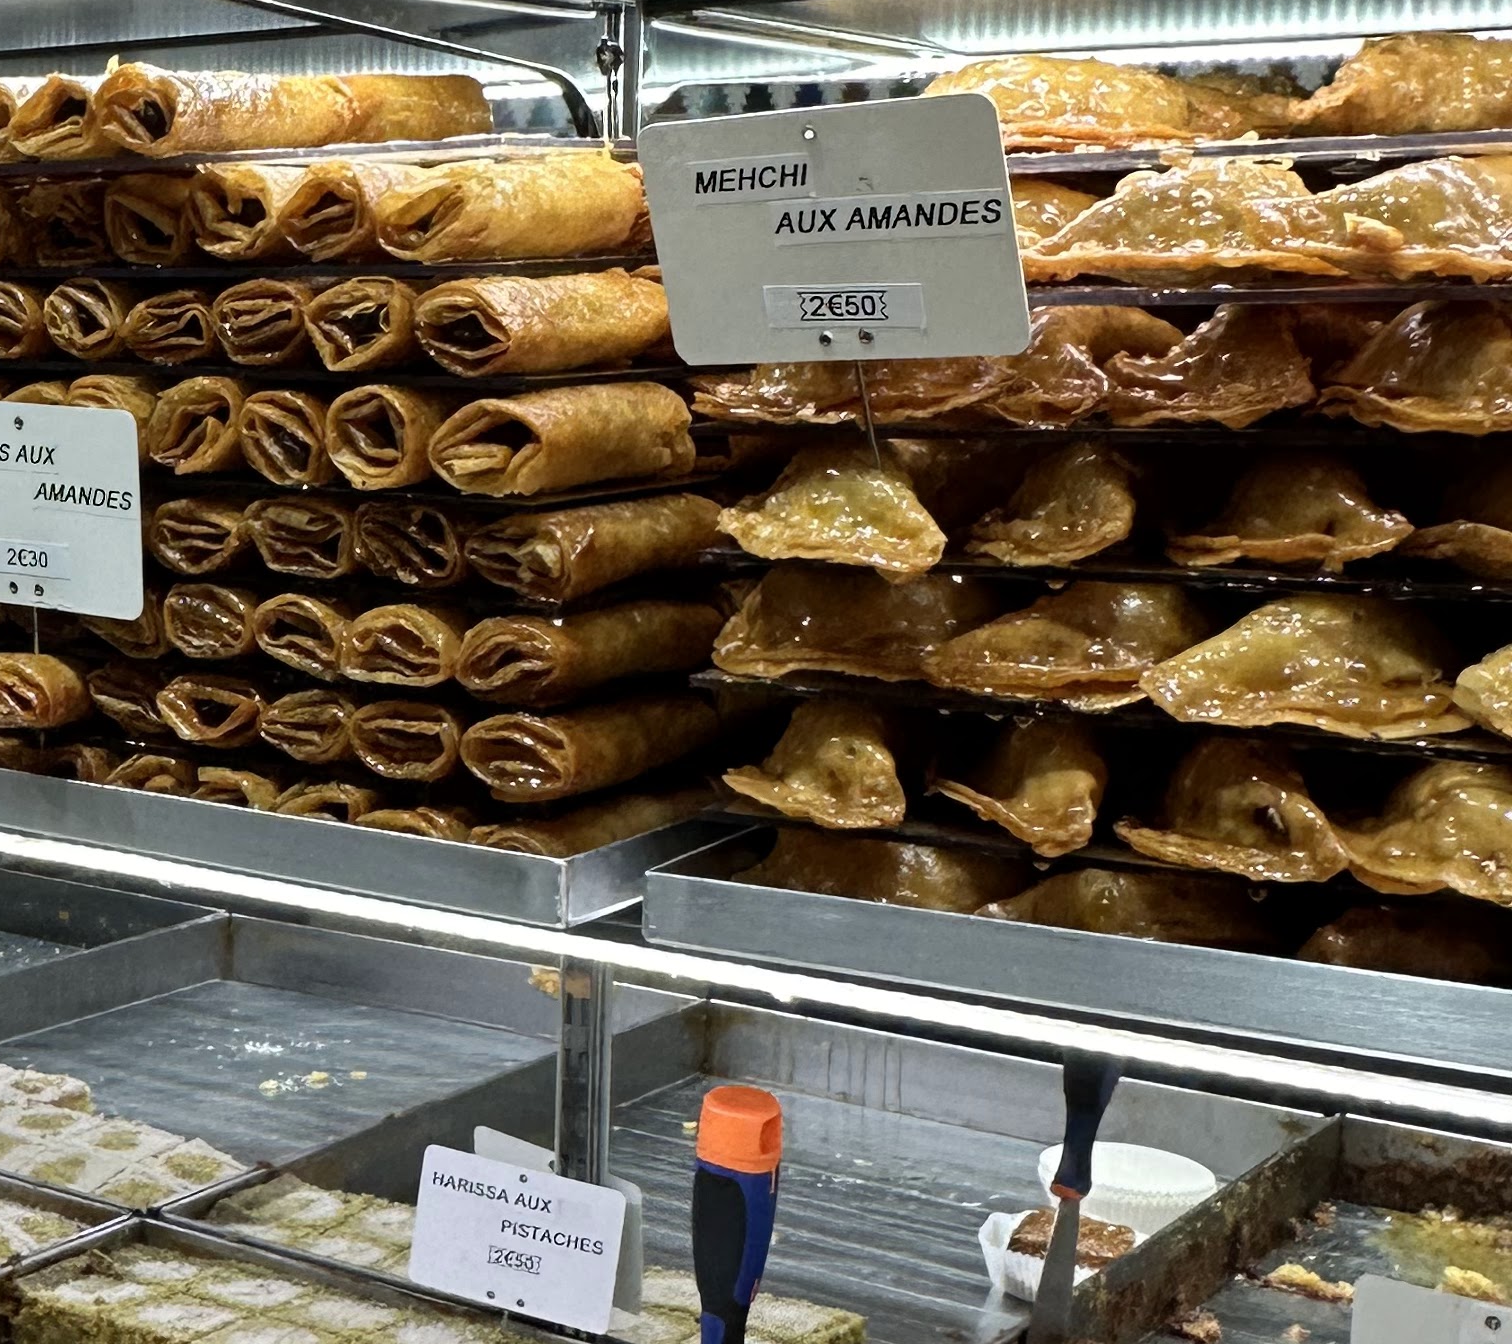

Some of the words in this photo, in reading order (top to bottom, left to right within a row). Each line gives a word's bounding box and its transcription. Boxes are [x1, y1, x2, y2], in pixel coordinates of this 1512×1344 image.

[695, 163, 808, 195] MEHCHI
[774, 209, 837, 235] AUX
[845, 198, 1002, 231] AMANDES
[809, 294, 876, 318] 2€50
[15, 445, 56, 466] AUX
[33, 482, 133, 511] AMANDES
[7, 548, 48, 569] 2€30
[432, 1171, 509, 1204] HARISSA
[514, 1192, 553, 1214] AUX
[500, 1219, 604, 1256] PISTACHES
